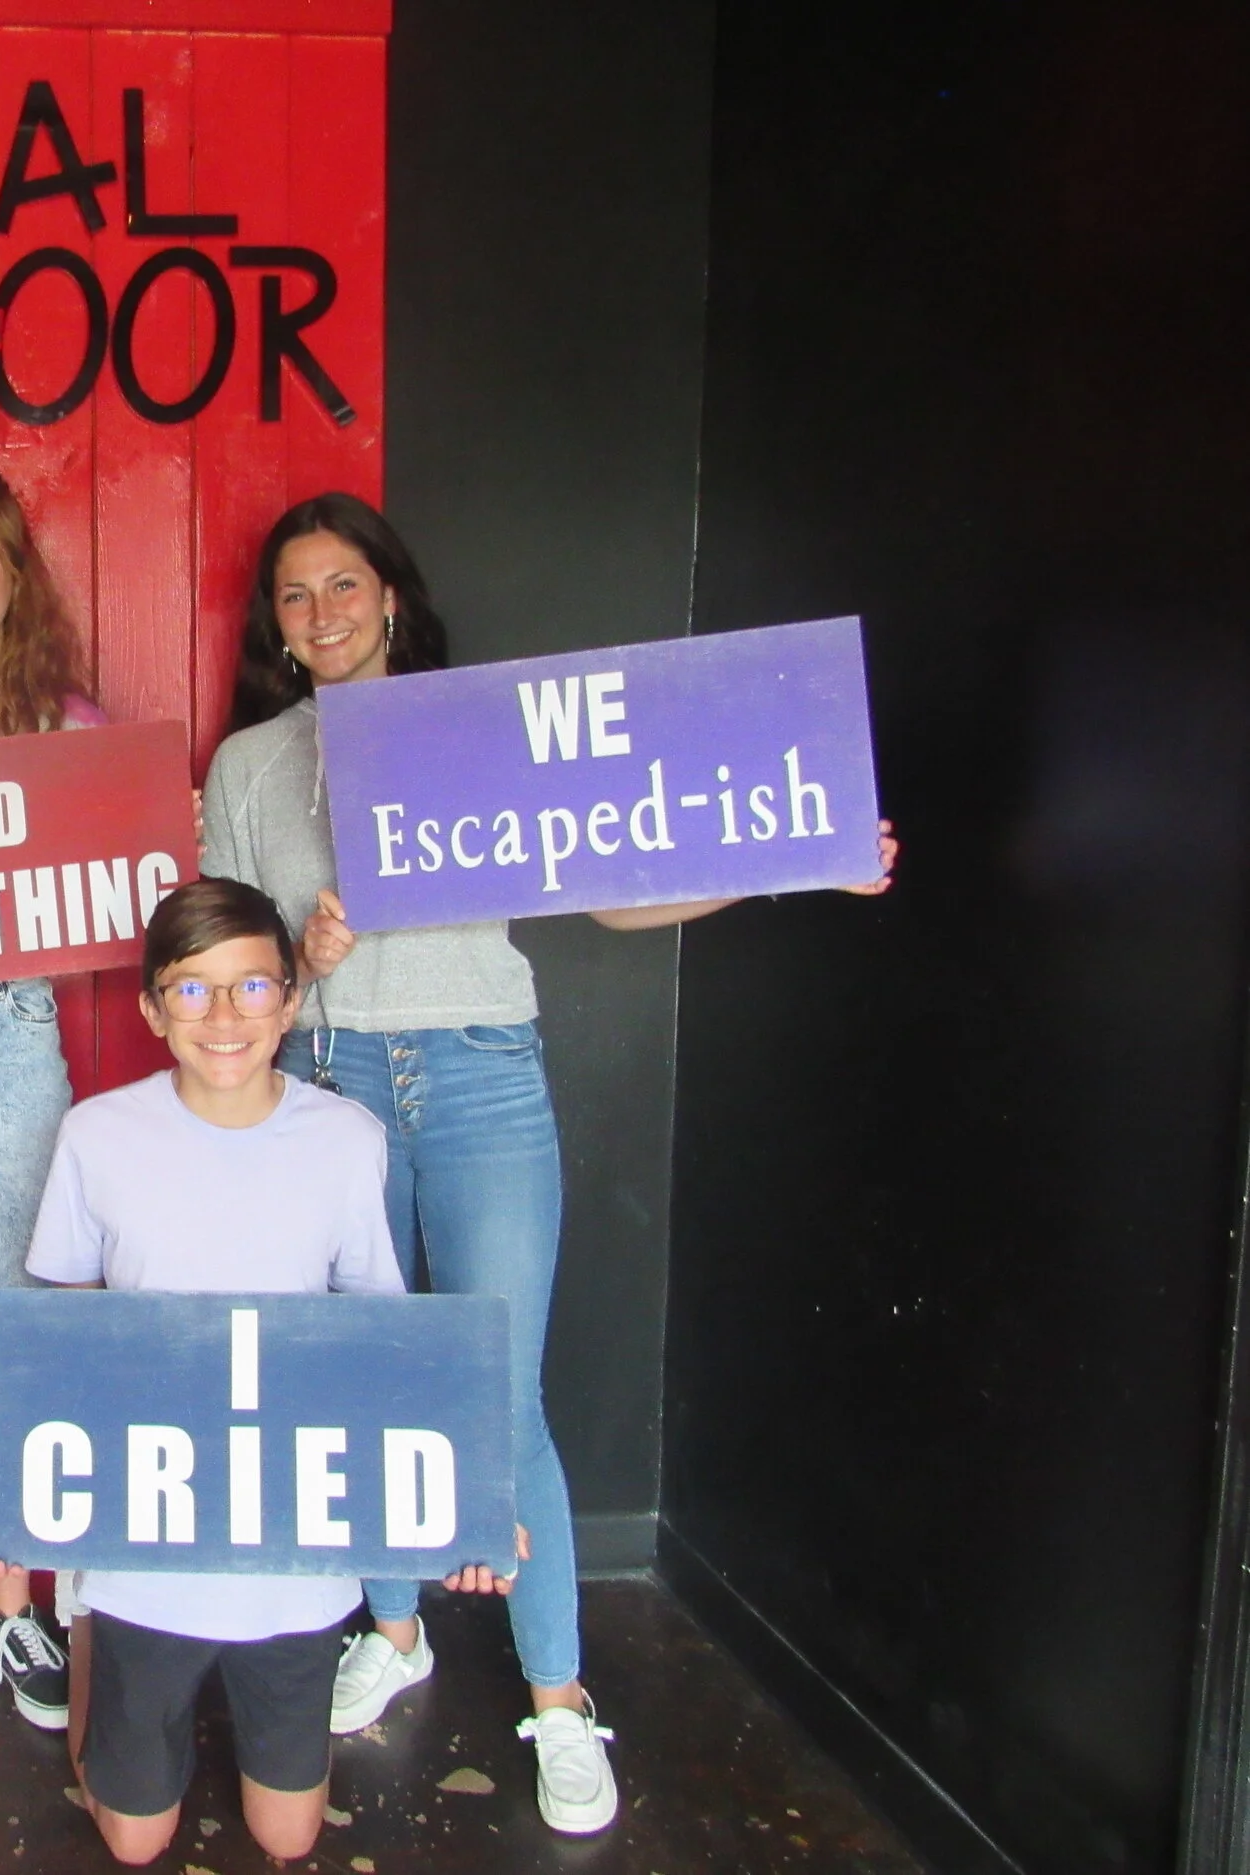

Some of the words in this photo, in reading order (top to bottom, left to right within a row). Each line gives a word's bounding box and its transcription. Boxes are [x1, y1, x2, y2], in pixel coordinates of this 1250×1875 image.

[517, 671, 631, 765] WE
[372, 745, 835, 893] Escaped-ish
[231, 1308, 259, 1411] I
[22, 1420, 457, 1549] CRIED
